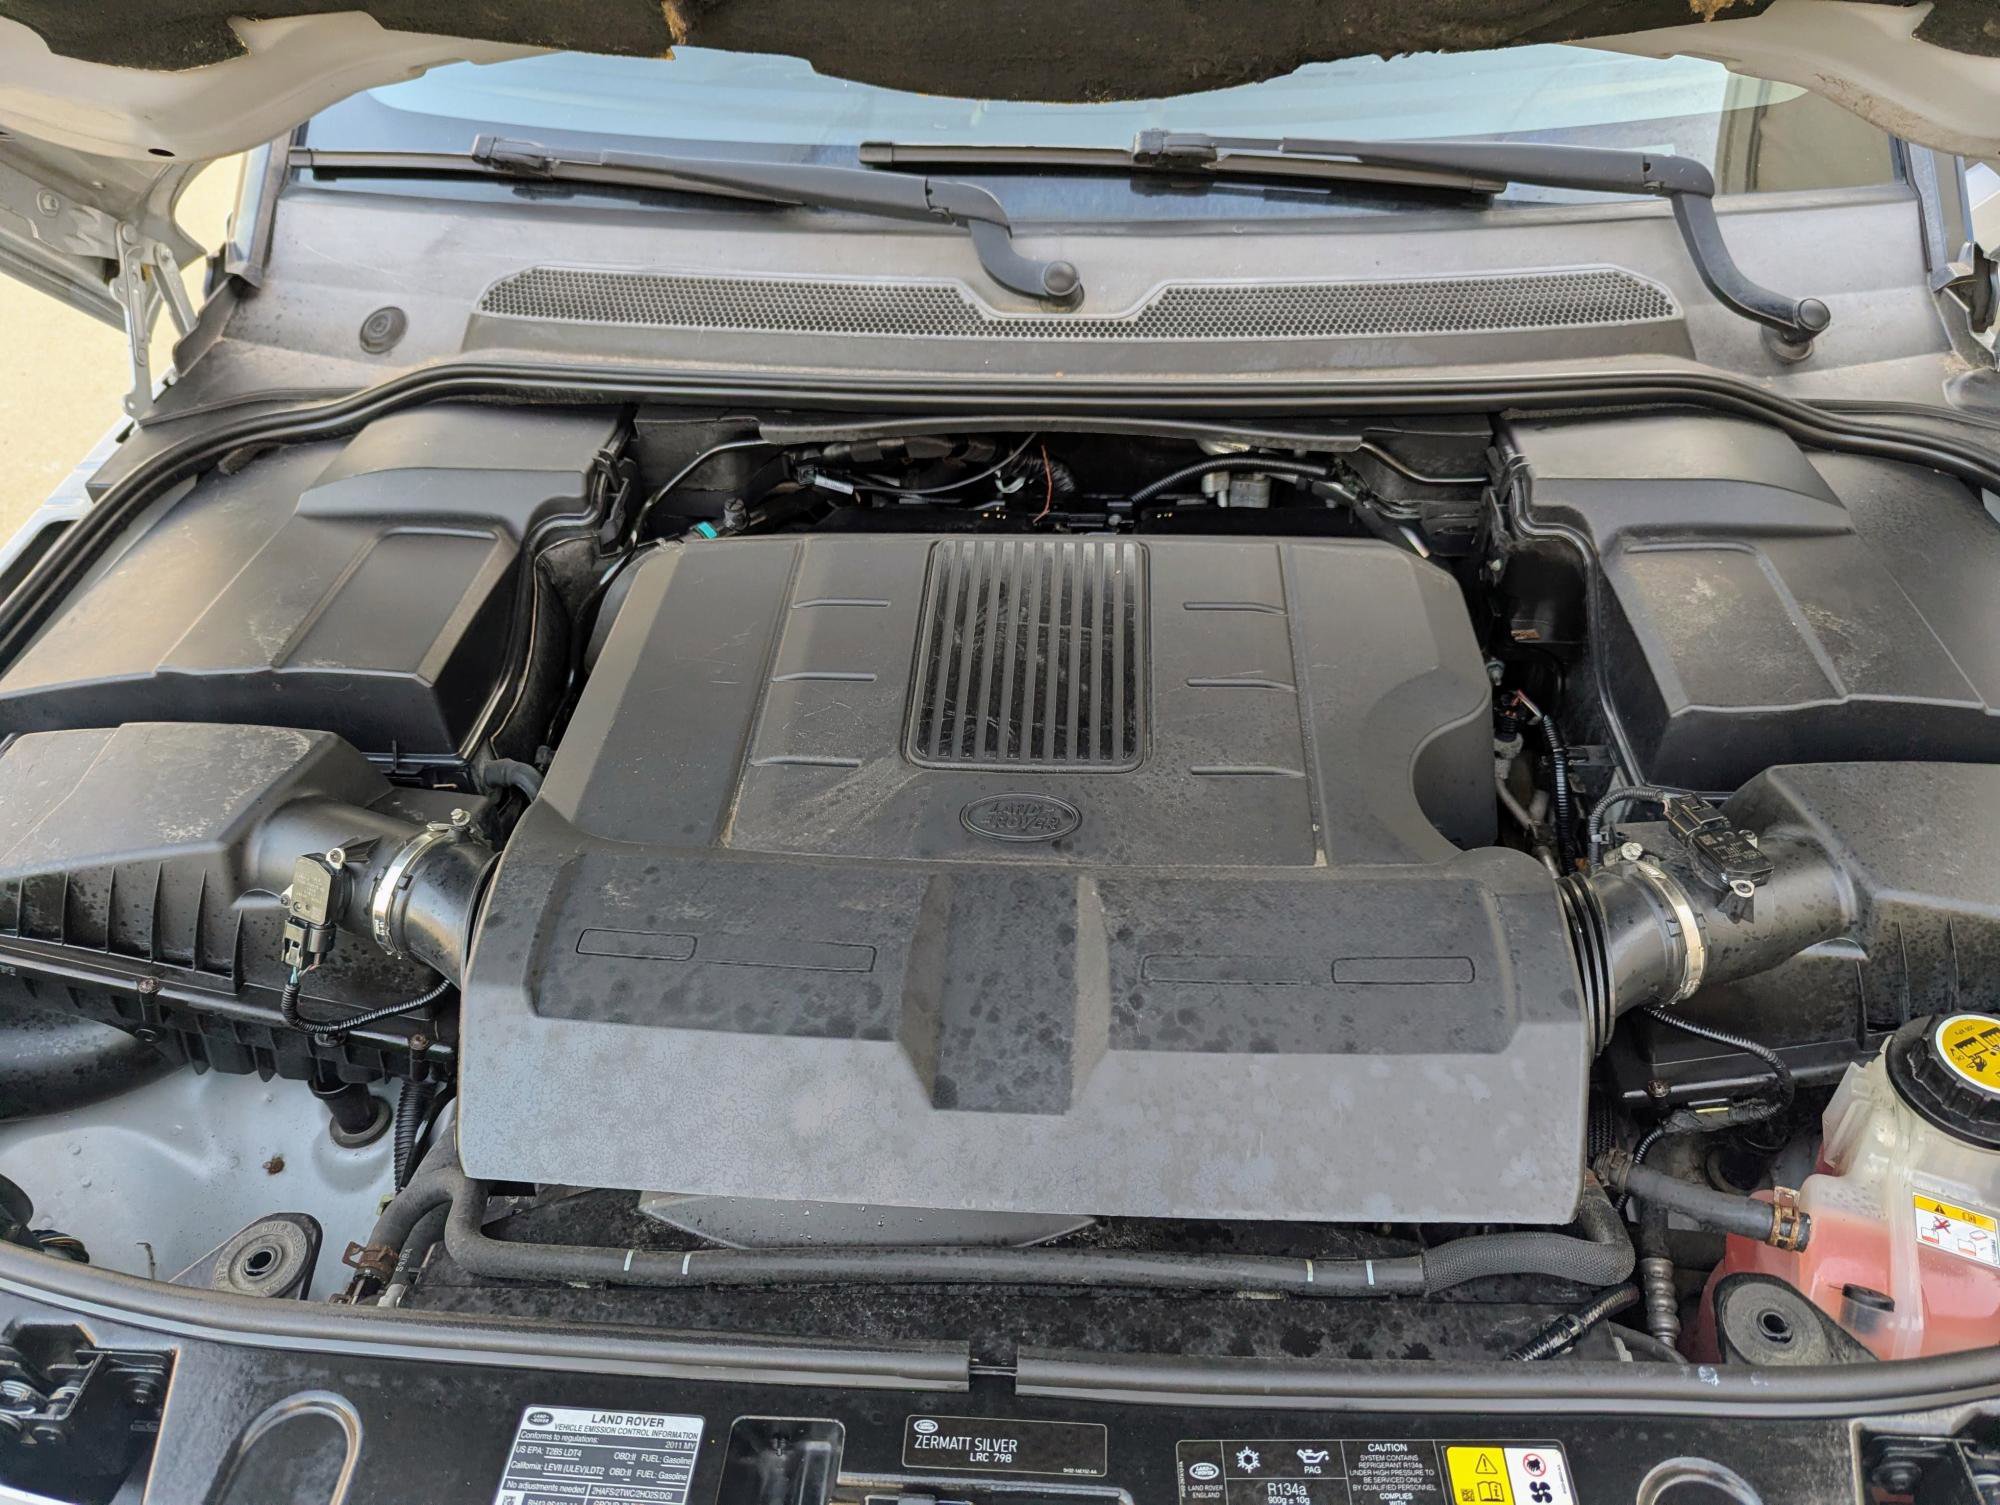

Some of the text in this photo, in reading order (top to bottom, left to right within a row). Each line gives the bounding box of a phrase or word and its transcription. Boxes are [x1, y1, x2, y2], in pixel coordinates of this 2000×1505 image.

[592, 1414, 665, 1428] LAND ROVER
[521, 1431, 552, 1440] Conforms
[561, 1434, 598, 1443] regulations:
[554, 1424, 699, 1439] VEHICLE EMISSION CONTROL INFORMATION
[516, 1445, 526, 1453] US
[665, 1441, 696, 1450] 2011 MY
[914, 1435, 1018, 1453] ZERMATT SILVER
[1367, 1443, 1408, 1452] CAUTION
[641, 1454, 661, 1463] FUEL:
[663, 1456, 693, 1465] Gasoline
[970, 1453, 1013, 1463] LRC 798
[636, 1469, 657, 1479] FUEL:
[658, 1471, 688, 1481] Gasoline
[1304, 1466, 1322, 1474] PAG
[507, 1481, 585, 1494] No adjustments needed
[1267, 1482, 1307, 1496] R134a
